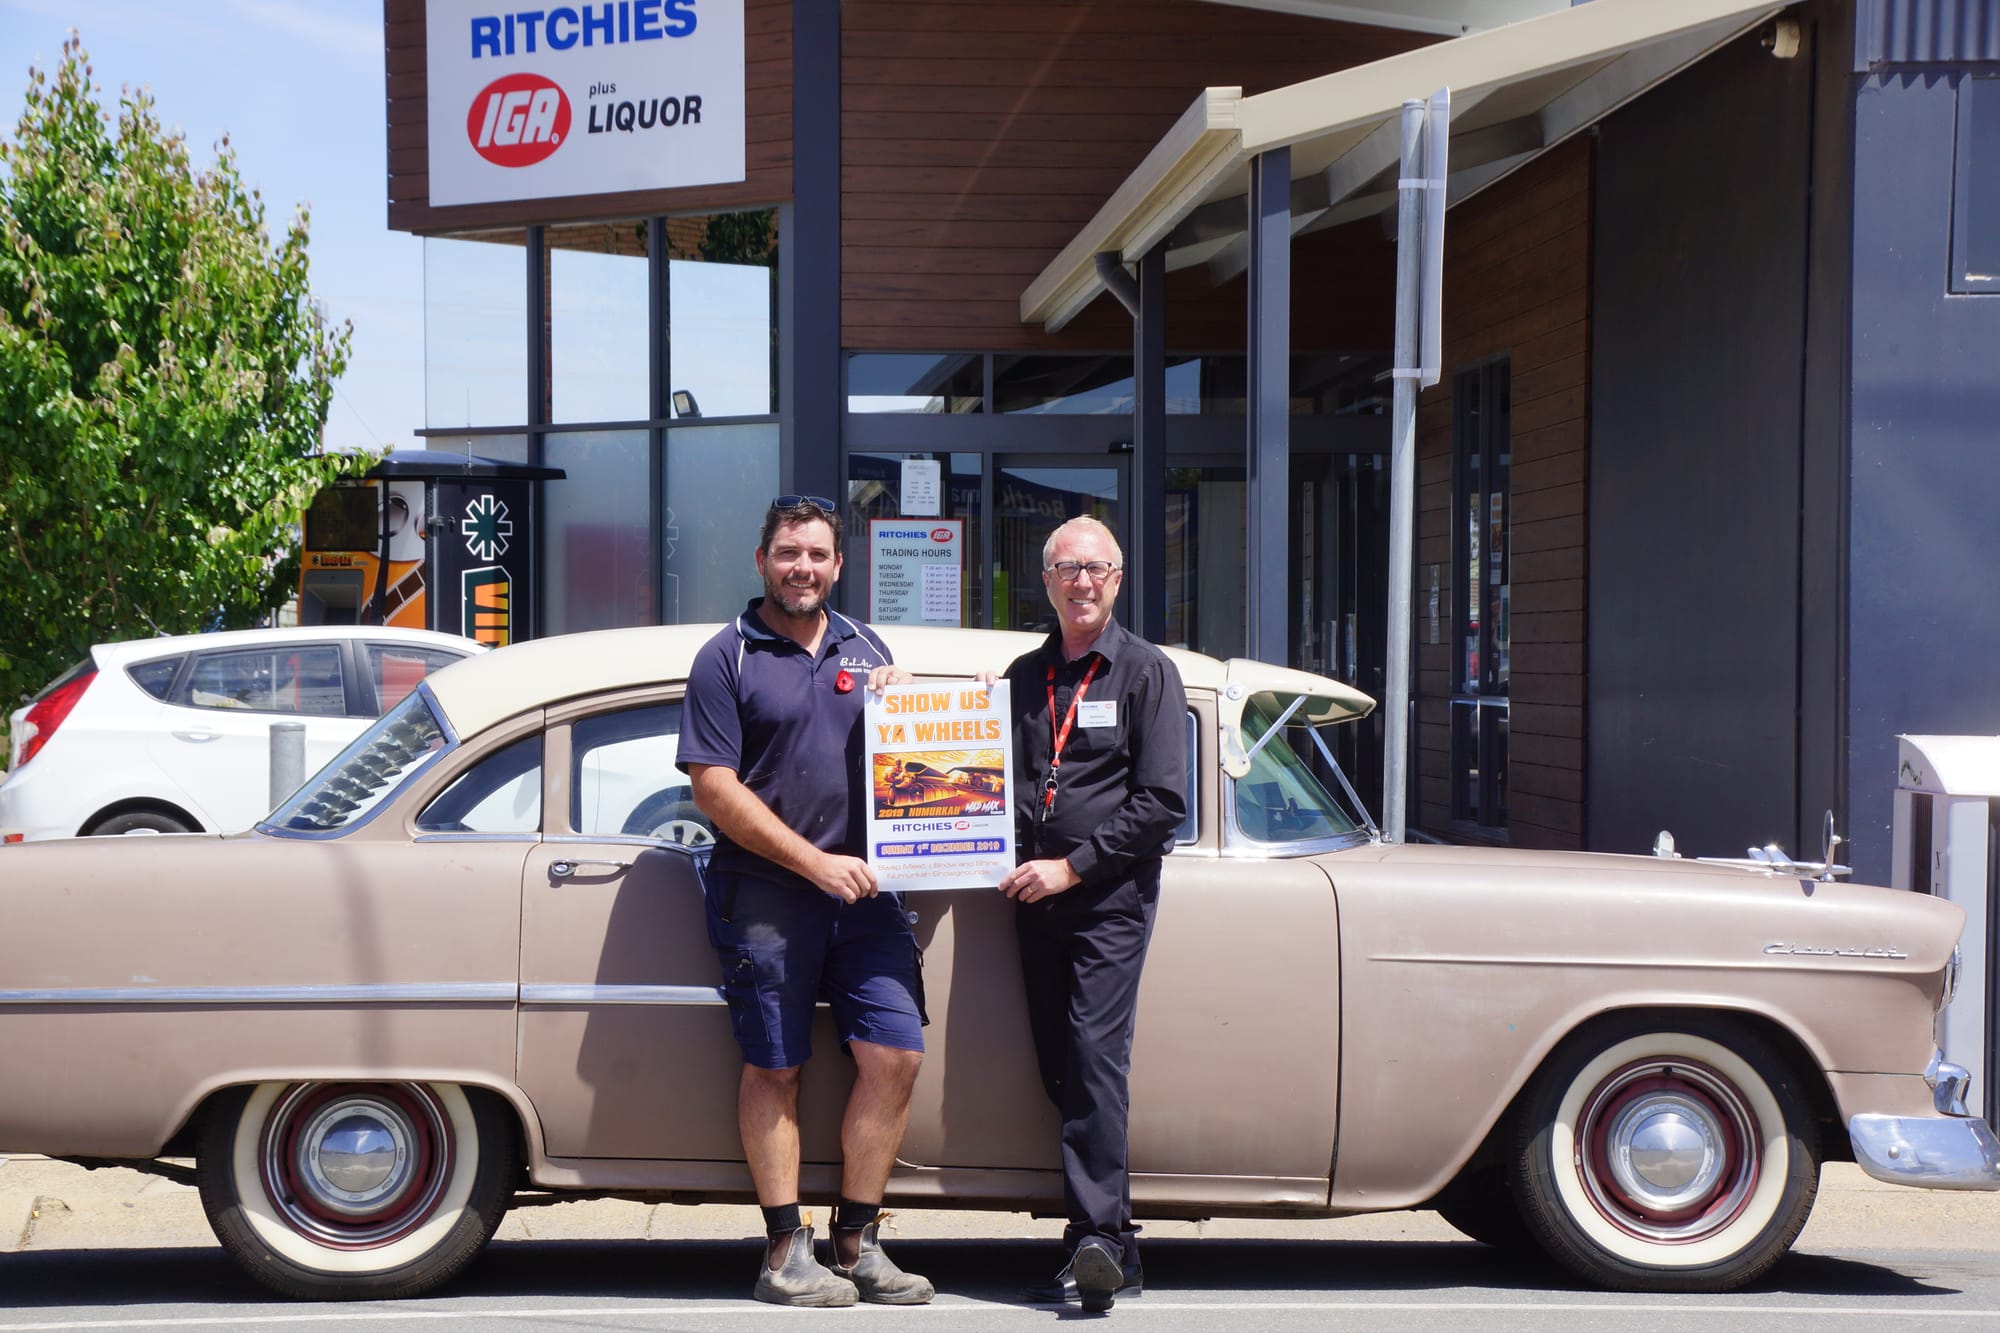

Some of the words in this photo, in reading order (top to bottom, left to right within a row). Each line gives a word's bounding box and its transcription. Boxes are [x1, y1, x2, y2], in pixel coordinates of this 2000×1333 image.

[471, 0, 698, 59] RITCHIES
[589, 81, 617, 98] plus
[477, 87, 561, 148] IGA
[588, 95, 703, 134] LIQUOR
[879, 531, 927, 539] RITCHIES
[881, 548, 919, 557] TRADING
[922, 548, 952, 557] HOURS
[885, 692, 951, 714] SHOW
[960, 689, 990, 710] US
[877, 723, 907, 744] YA
[914, 719, 1001, 742] WHEELS
[878, 808, 904, 818] 2019
[909, 806, 960, 817] NUMURKAH
[965, 801, 982, 813] MAD
[982, 800, 1000, 811] MAX
[892, 822, 952, 832] RITCHIES
